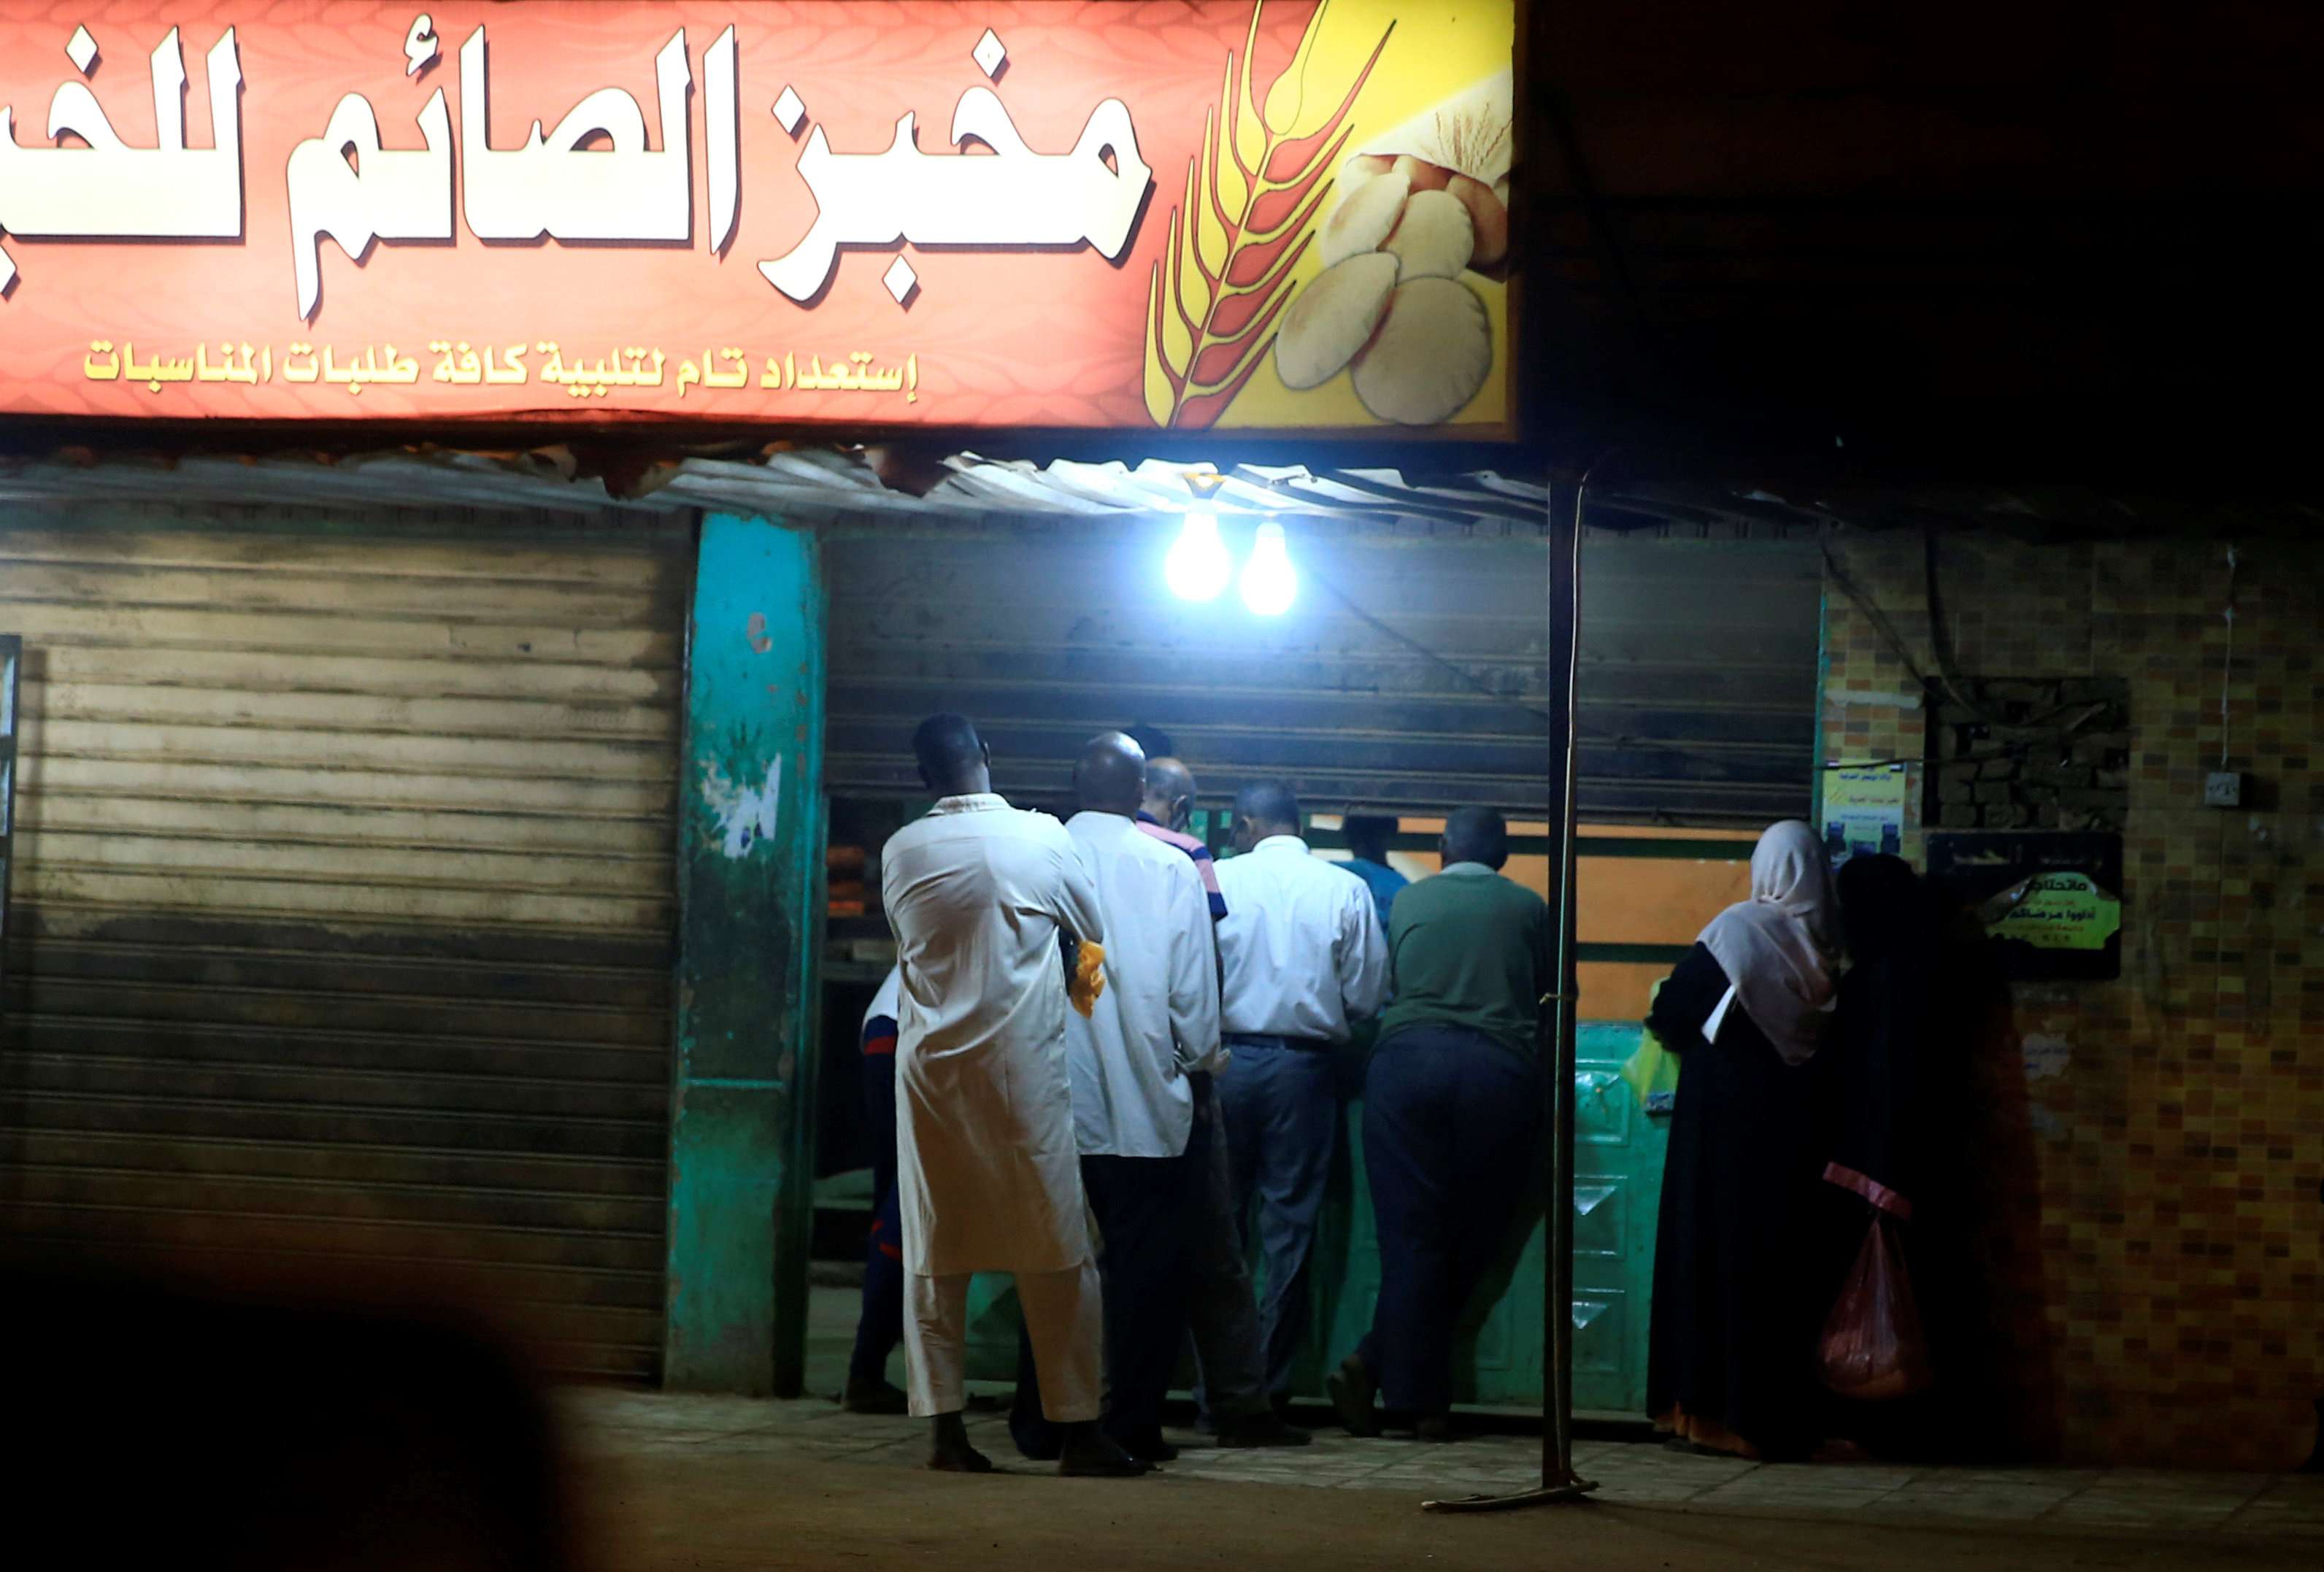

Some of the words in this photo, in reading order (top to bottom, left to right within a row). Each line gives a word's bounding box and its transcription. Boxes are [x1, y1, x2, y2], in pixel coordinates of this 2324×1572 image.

[0, 23, 245, 298] للخب
[285, 13, 738, 324] الصائم
[758, 28, 1153, 307] مخبز
[84, 339, 272, 393] المناسبات
[282, 342, 420, 395] طلبات
[428, 340, 527, 385] كافة
[536, 341, 665, 397] لتلبية
[676, 347, 749, 397] تام
[760, 350, 918, 404] إستعداد
